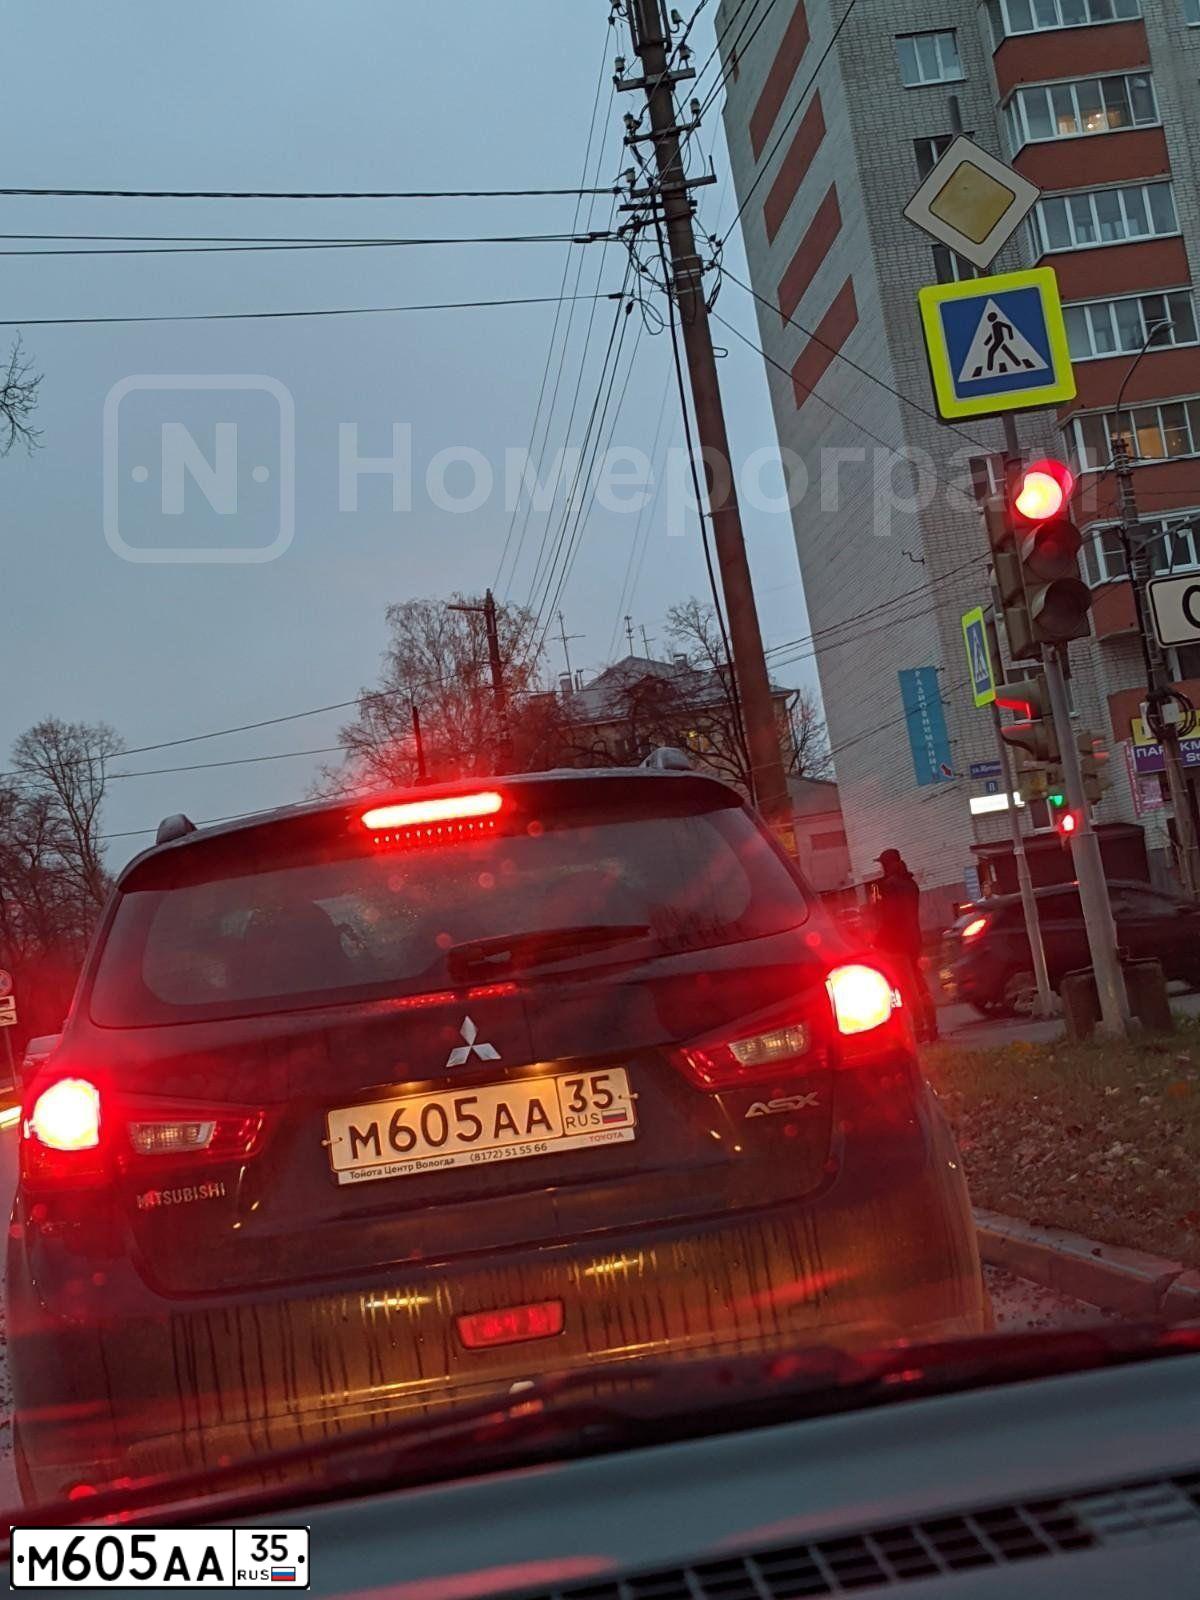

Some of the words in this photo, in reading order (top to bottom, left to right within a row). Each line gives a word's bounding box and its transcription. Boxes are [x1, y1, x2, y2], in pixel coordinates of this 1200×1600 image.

[564, 1075, 615, 1113] 35
[744, 1091, 820, 1118] ASX
[348, 1096, 554, 1160] М605АА
[565, 1112, 601, 1130] RUS
[588, 1131, 625, 1143] TOYOTA
[350, 1168, 383, 1180] Тойота
[384, 1162, 414, 1176] Центр
[415, 1157, 455, 1170] Вологда
[469, 1149, 503, 1163] (8172)
[505, 1147, 517, 1157] 51
[517, 1145, 533, 1156] 55
[534, 1142, 548, 1153] 66
[136, 1182, 226, 1209] MITSUBISHI
